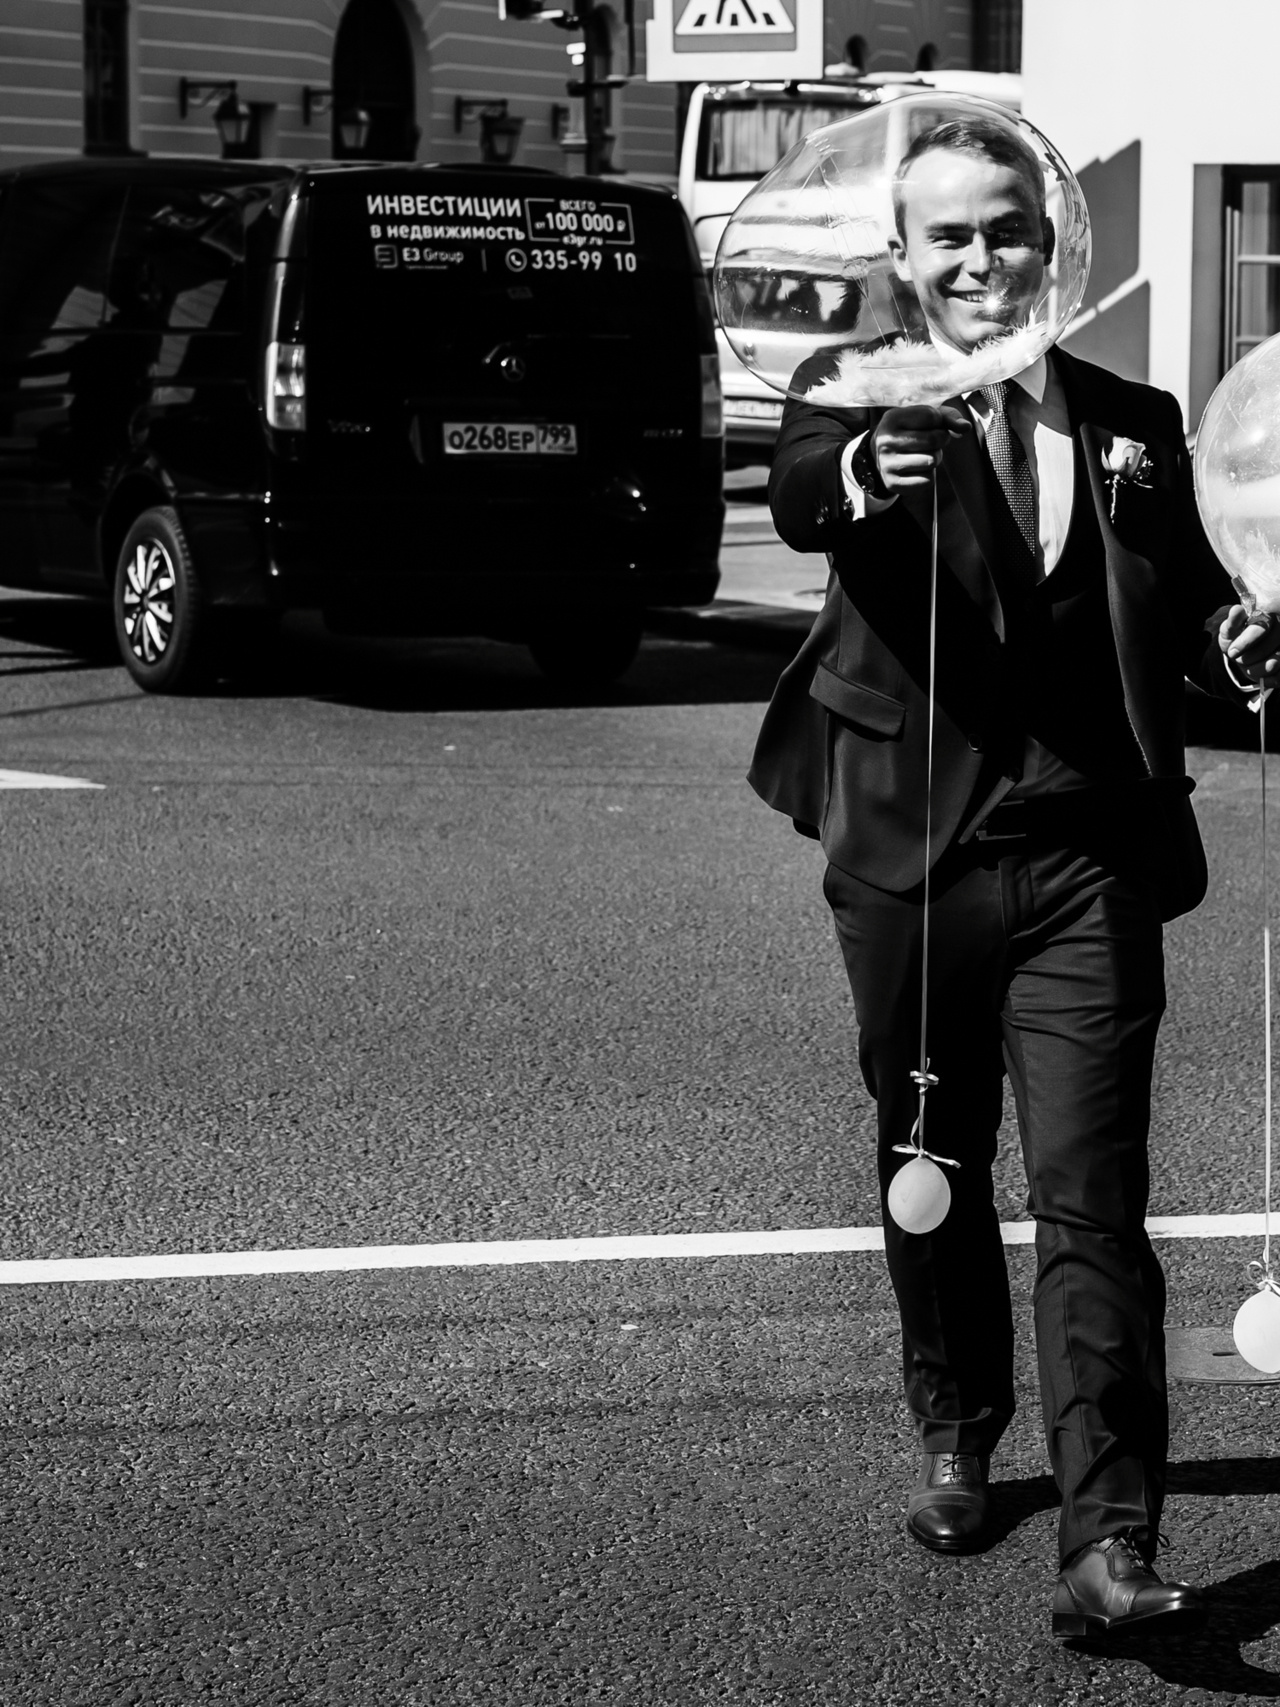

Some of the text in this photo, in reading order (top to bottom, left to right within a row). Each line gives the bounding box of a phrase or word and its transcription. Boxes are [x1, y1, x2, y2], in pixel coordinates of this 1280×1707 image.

[366, 195, 522, 220] ИНВЕСТИЦИИ
[546, 212, 578, 231] 100
[581, 213, 615, 233] 000
[370, 224, 526, 242] в недвижимость
[422, 247, 465, 265] Group
[531, 249, 637, 272] 335-99 10
[538, 425, 572, 445] 799
